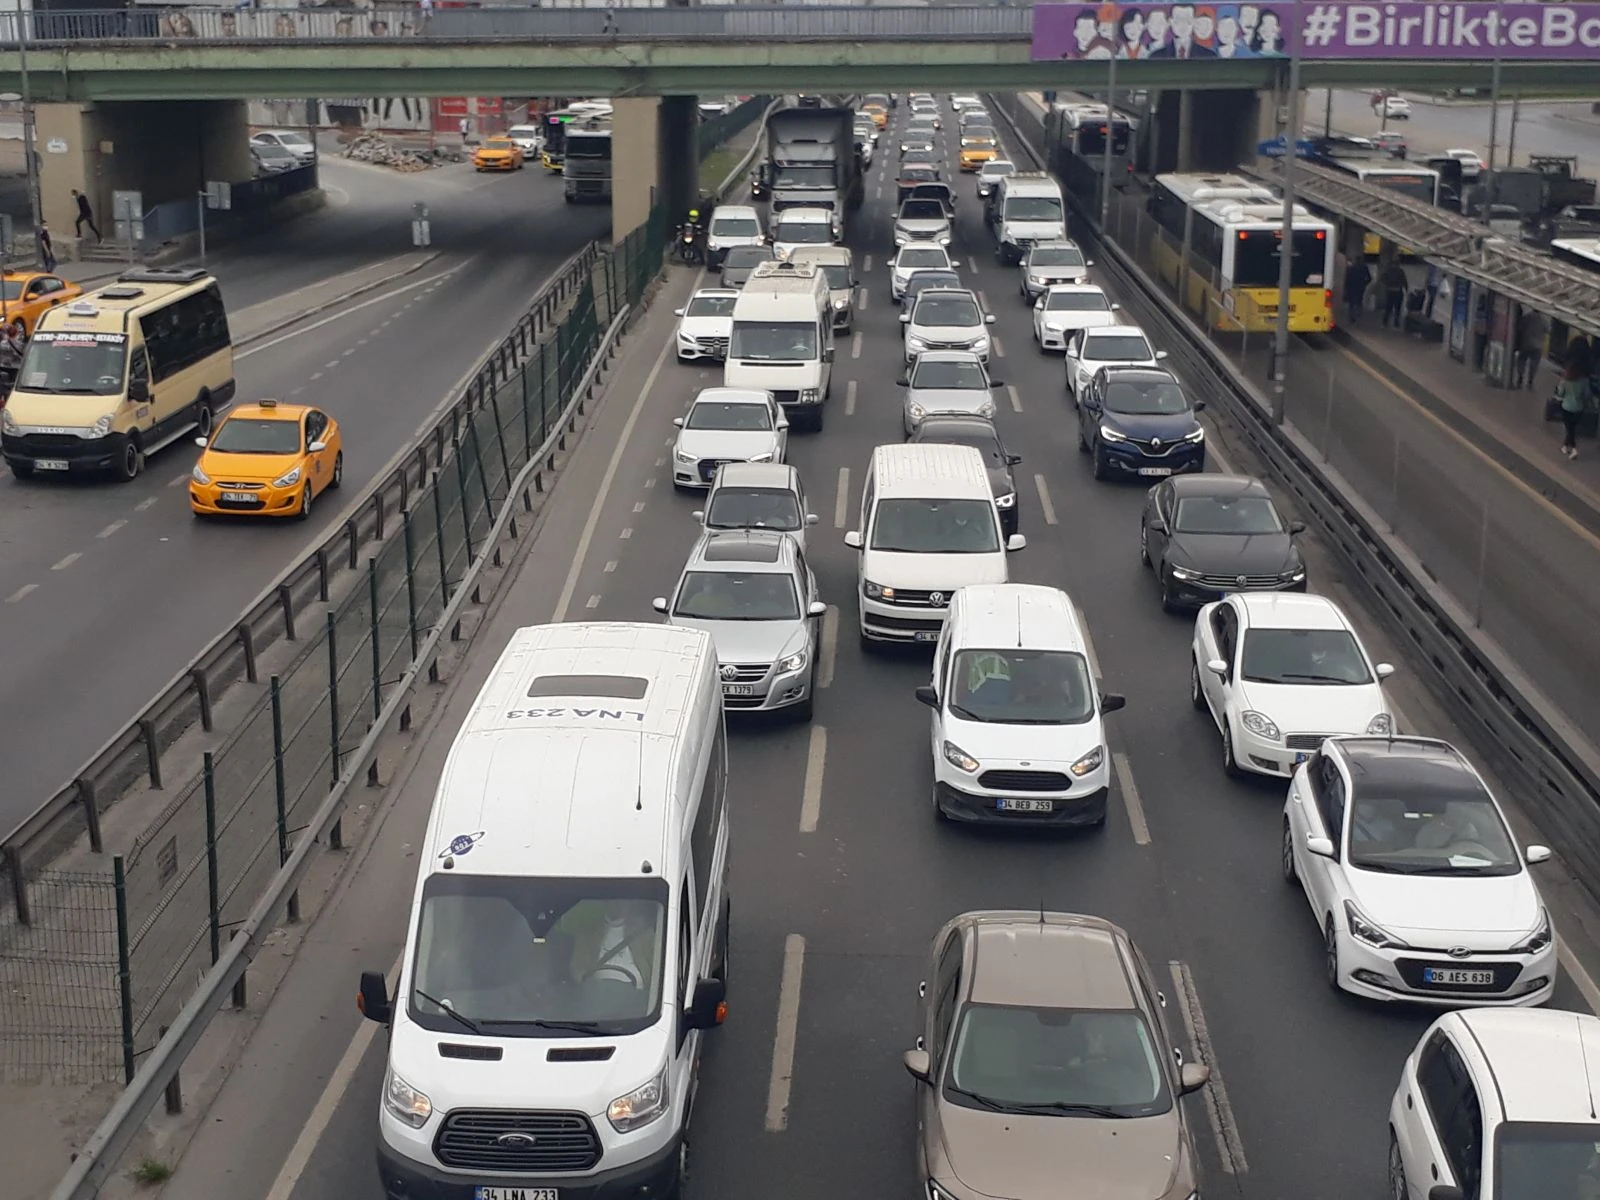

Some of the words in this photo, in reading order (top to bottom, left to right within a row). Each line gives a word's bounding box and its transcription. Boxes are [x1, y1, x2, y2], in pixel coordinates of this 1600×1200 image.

[734, 686, 752, 695] 1379
[1035, 801, 1050, 811] 259
[1431, 971, 1445, 982] 06
[1448, 971, 1468, 983] AES
[1471, 972, 1491, 984] 638
[482, 1188, 498, 1200] 34
